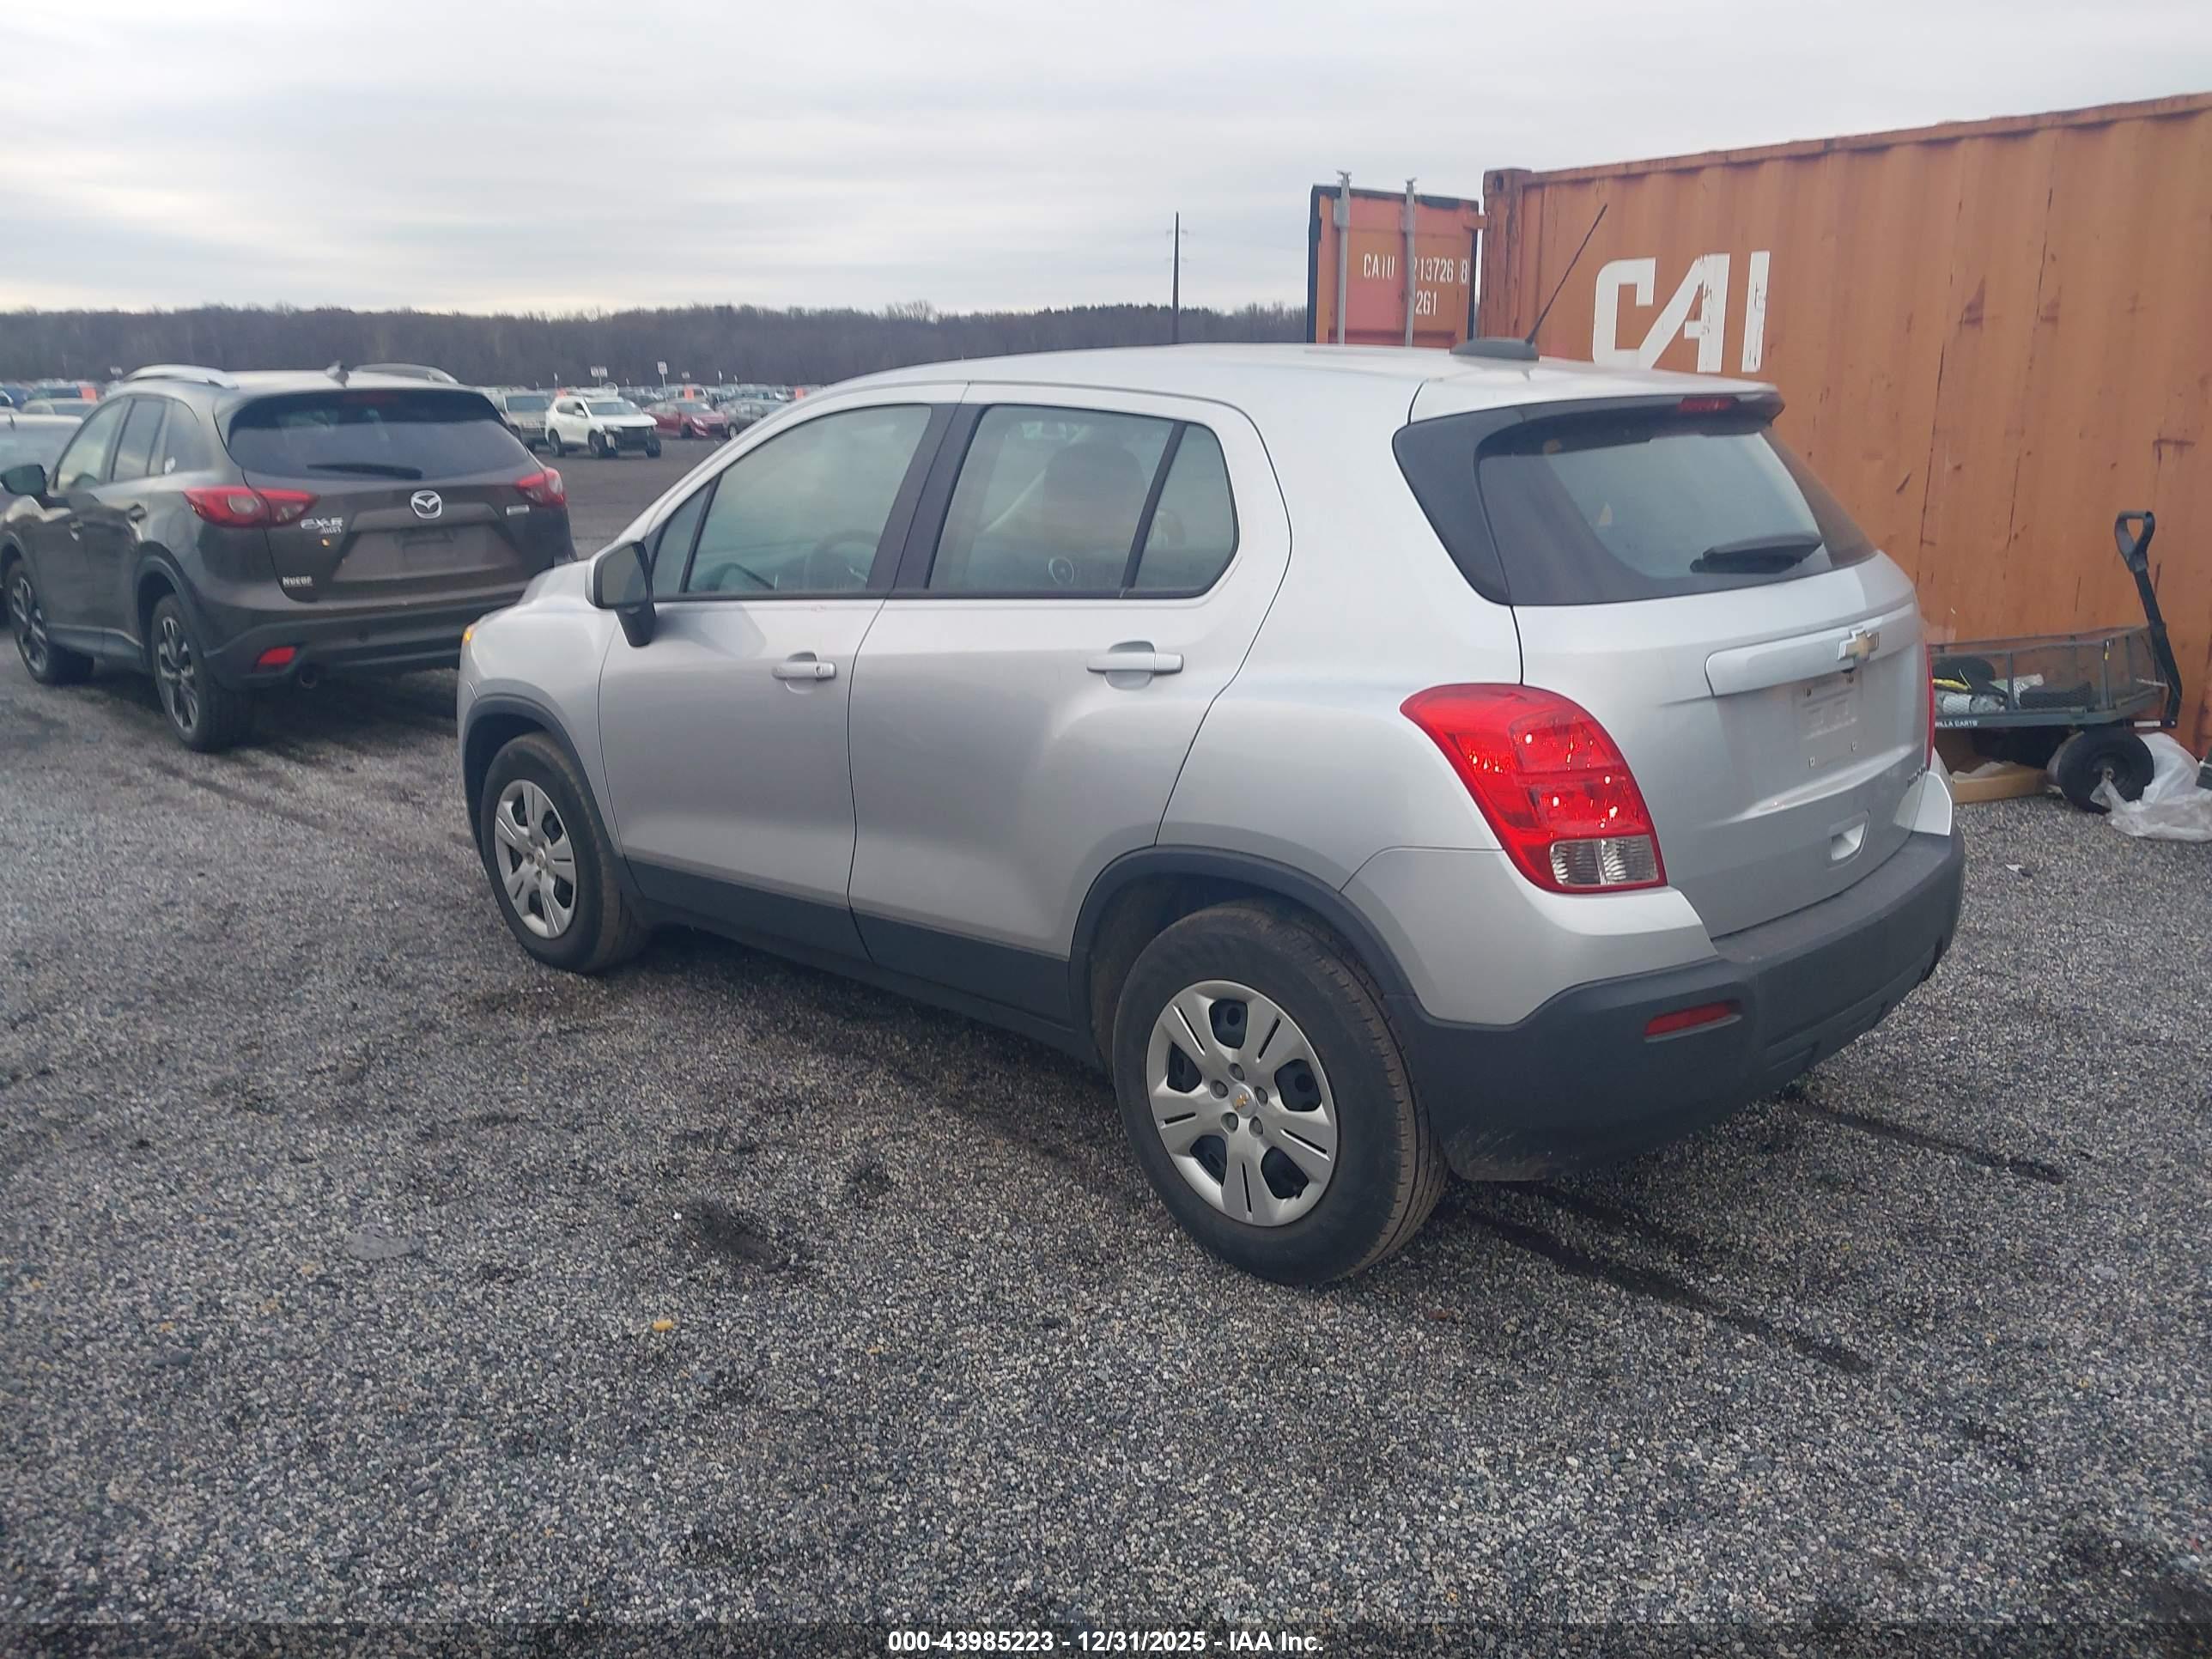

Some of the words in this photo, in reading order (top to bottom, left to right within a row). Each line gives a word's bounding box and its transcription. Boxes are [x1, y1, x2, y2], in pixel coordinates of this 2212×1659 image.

[1363, 252, 1395, 281] CAIU
[1460, 258, 1469, 284] 8
[1592, 250, 1771, 374] CAI
